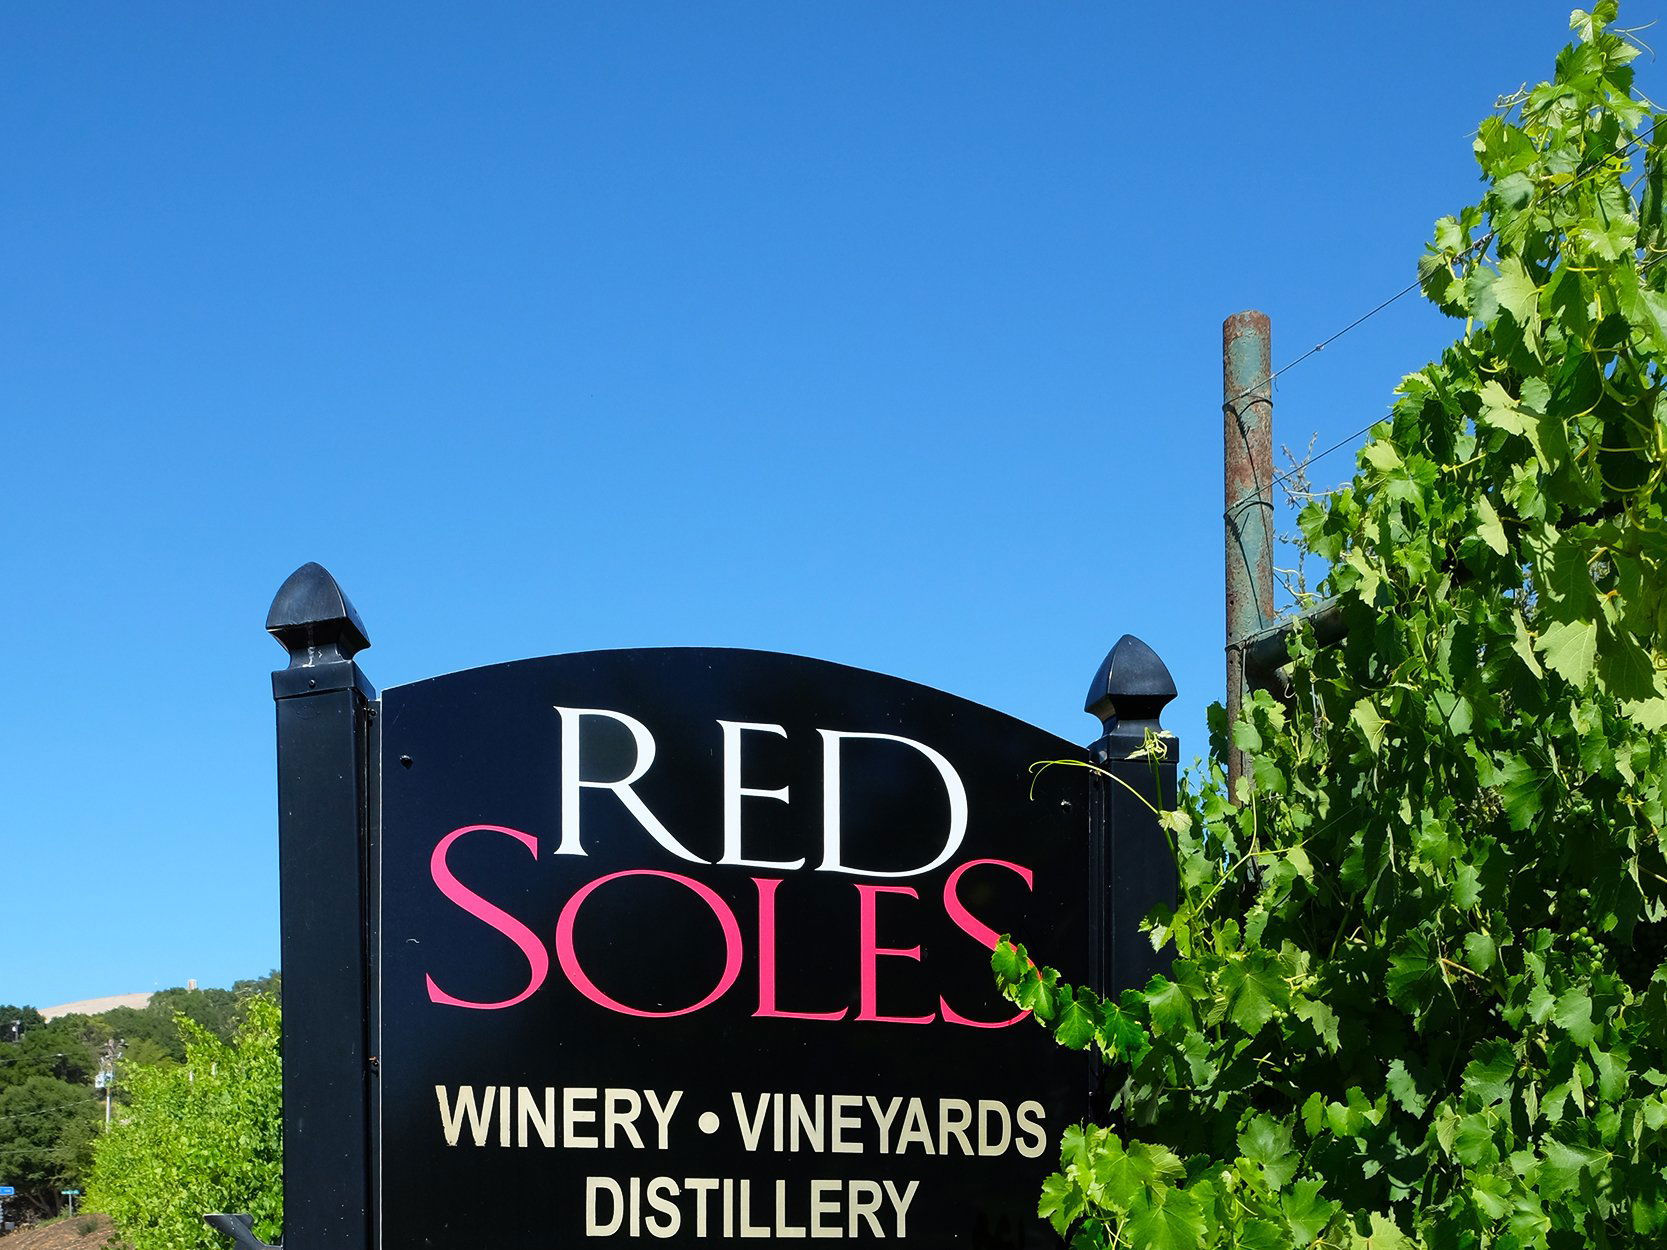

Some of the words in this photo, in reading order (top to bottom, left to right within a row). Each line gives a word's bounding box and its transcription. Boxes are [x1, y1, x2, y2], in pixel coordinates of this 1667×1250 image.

[553, 705, 968, 878] RED
[425, 824, 1035, 1029] SOLES
[435, 1085, 683, 1149] WINERY
[731, 1092, 1047, 1159] VINEYARDS
[585, 1176, 920, 1239] DISTILLERY
